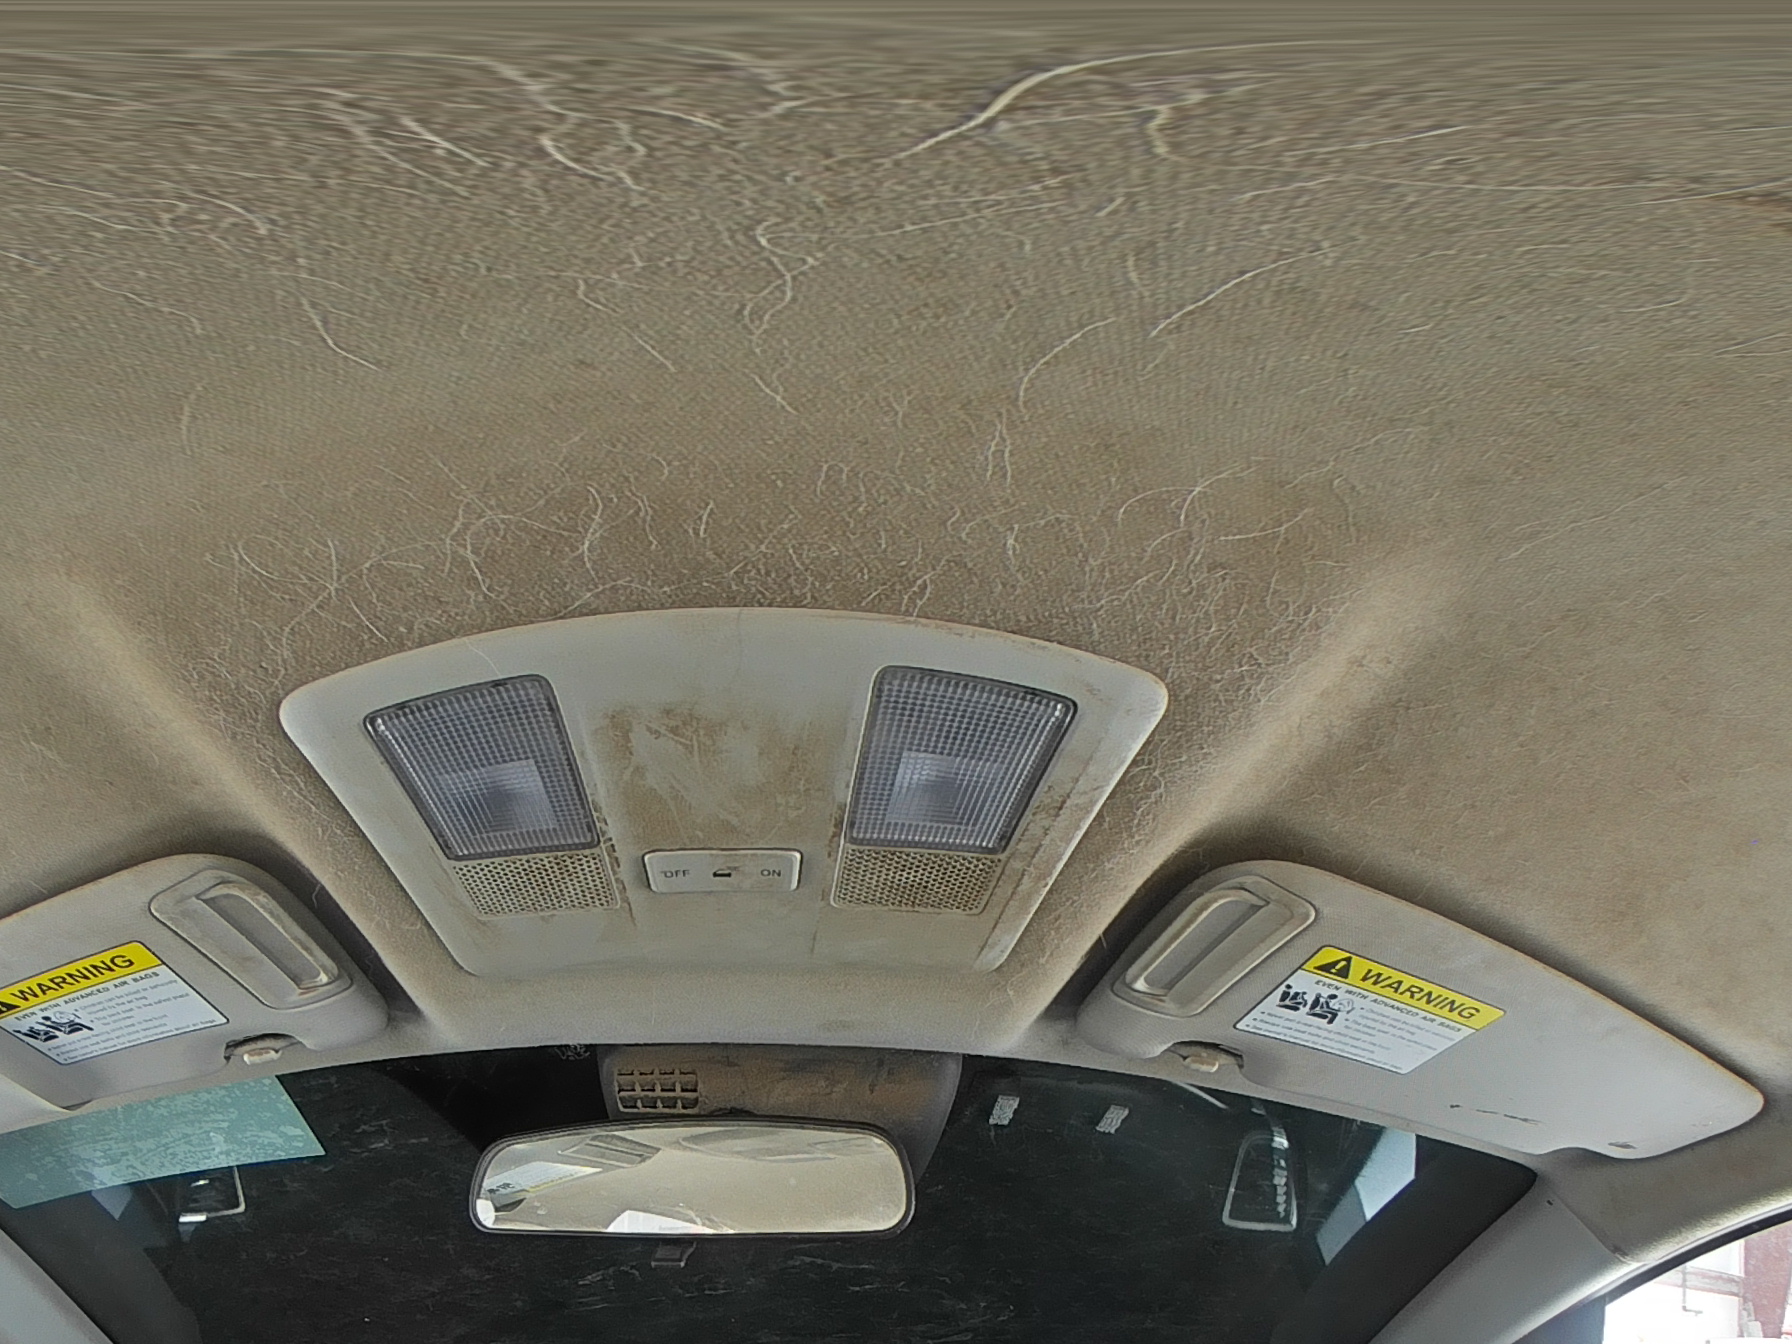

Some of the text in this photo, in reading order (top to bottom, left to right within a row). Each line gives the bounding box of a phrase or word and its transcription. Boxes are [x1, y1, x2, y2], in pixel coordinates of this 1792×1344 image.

[760, 868, 781, 877] ON
[10, 954, 135, 1002] WARNING
[14, 971, 160, 1021] EVEN WITH ADVANCED AIR BAGS
[1315, 979, 1341, 991] EVEN
[1344, 986, 1369, 1000] WITH
[1371, 998, 1419, 1017] ADVANCED
[1360, 968, 1480, 1020] WARNING
